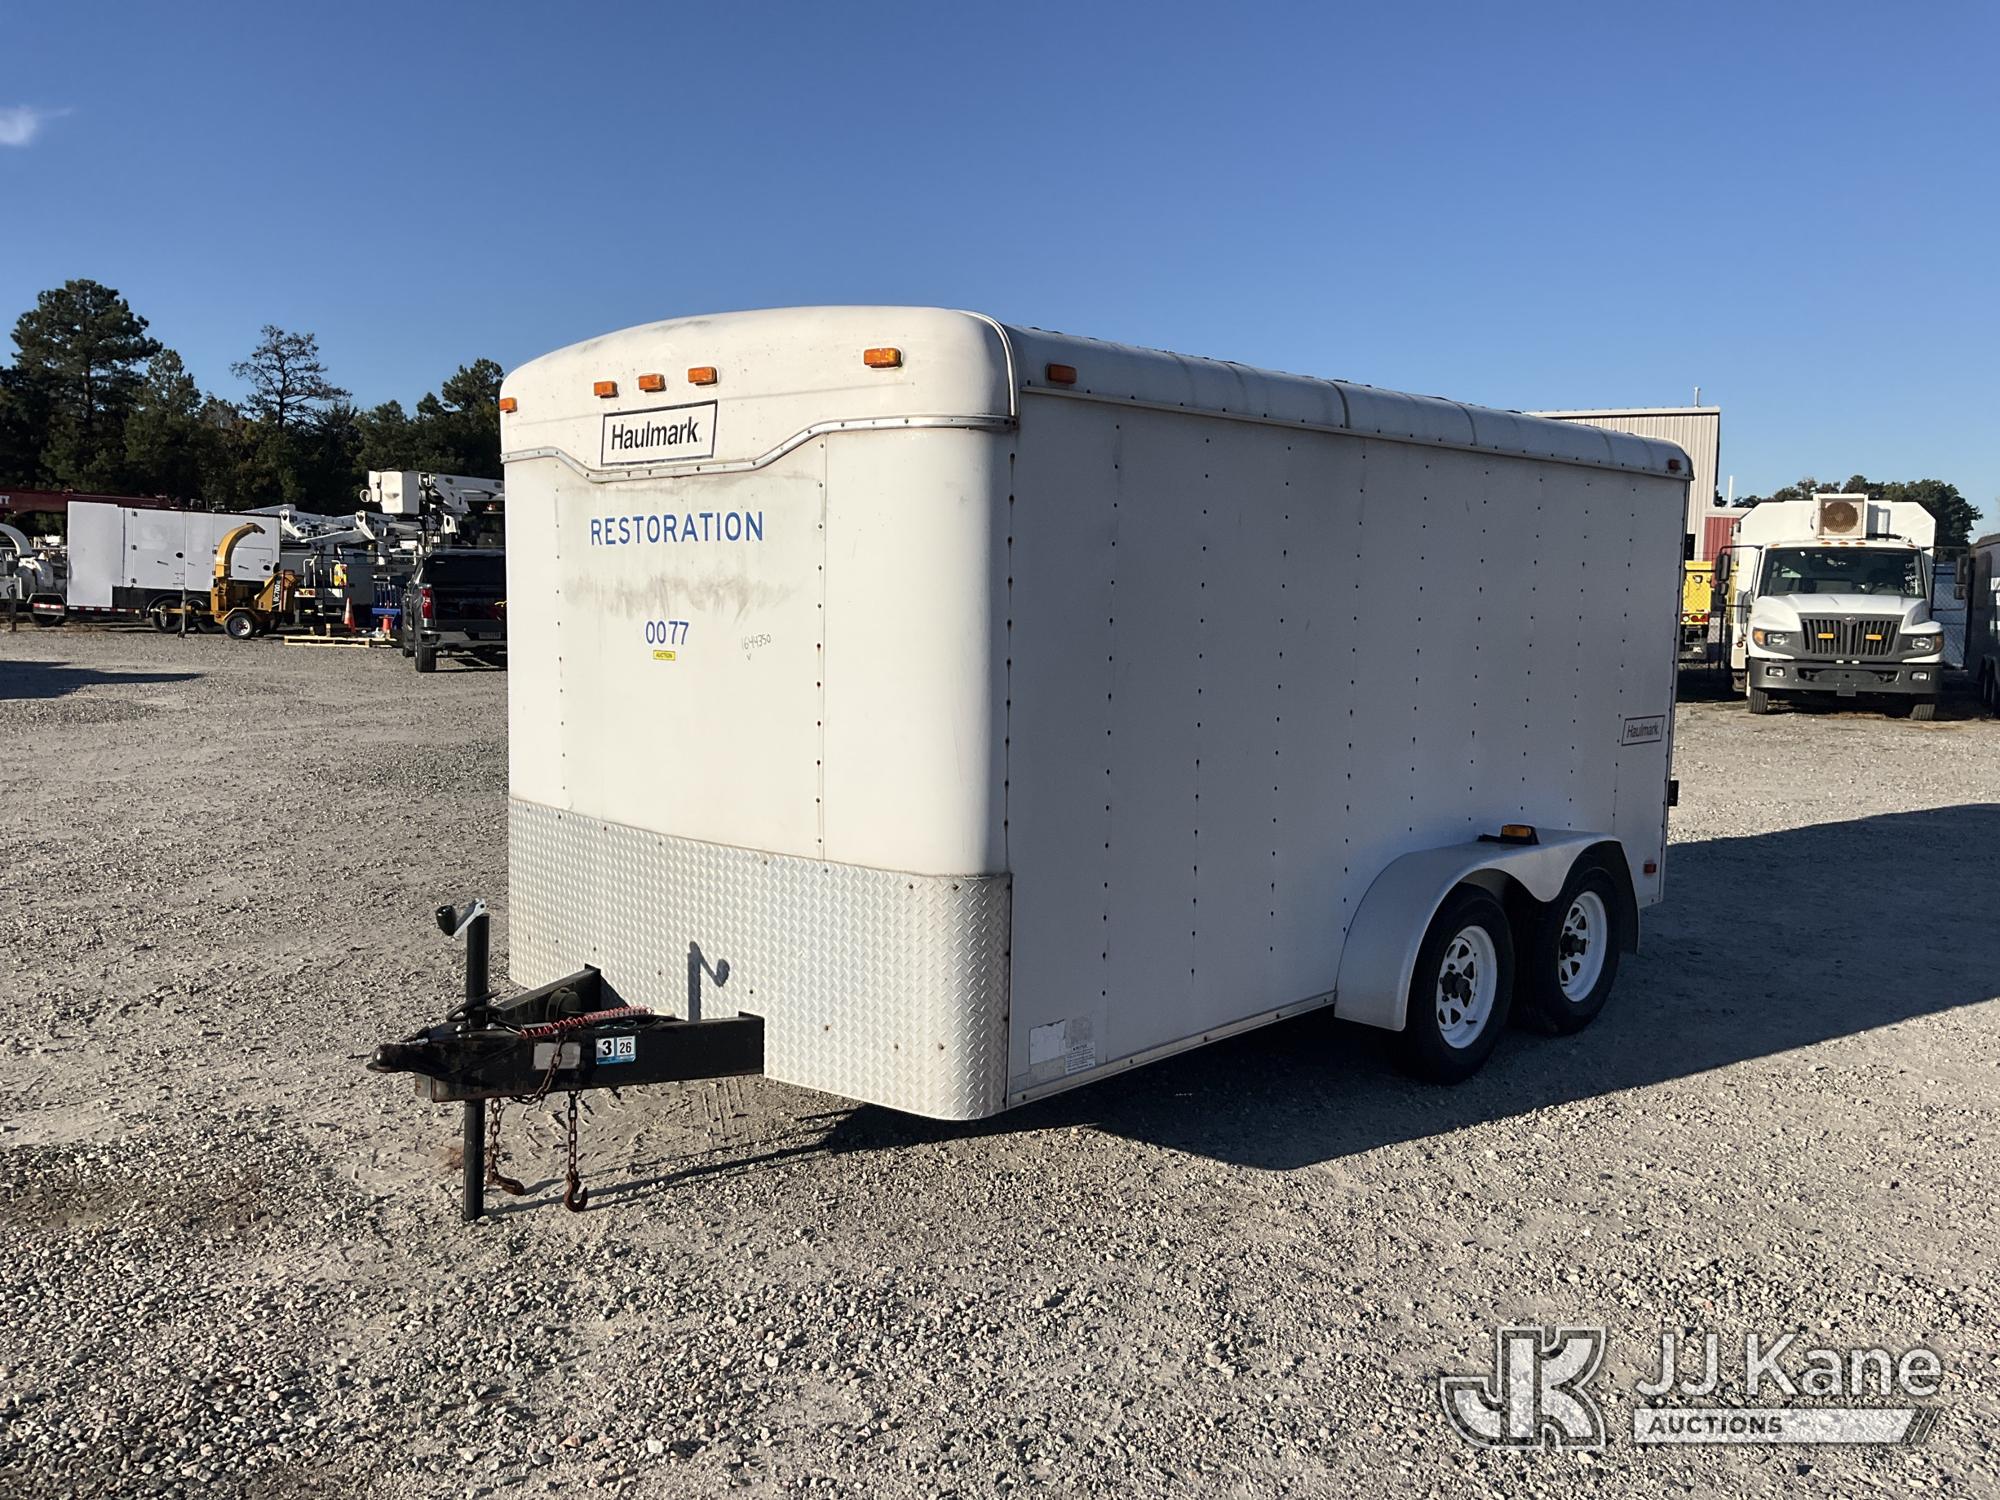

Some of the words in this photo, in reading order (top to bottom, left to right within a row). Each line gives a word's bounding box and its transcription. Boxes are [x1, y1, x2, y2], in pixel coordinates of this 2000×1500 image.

[611, 416, 699, 451] Haulmark
[590, 511, 763, 546] RESTORATION
[645, 620, 689, 645] 0077
[1626, 722, 1659, 738] Haulmark
[602, 1040, 612, 1056] 3
[619, 1042, 632, 1054] 26
